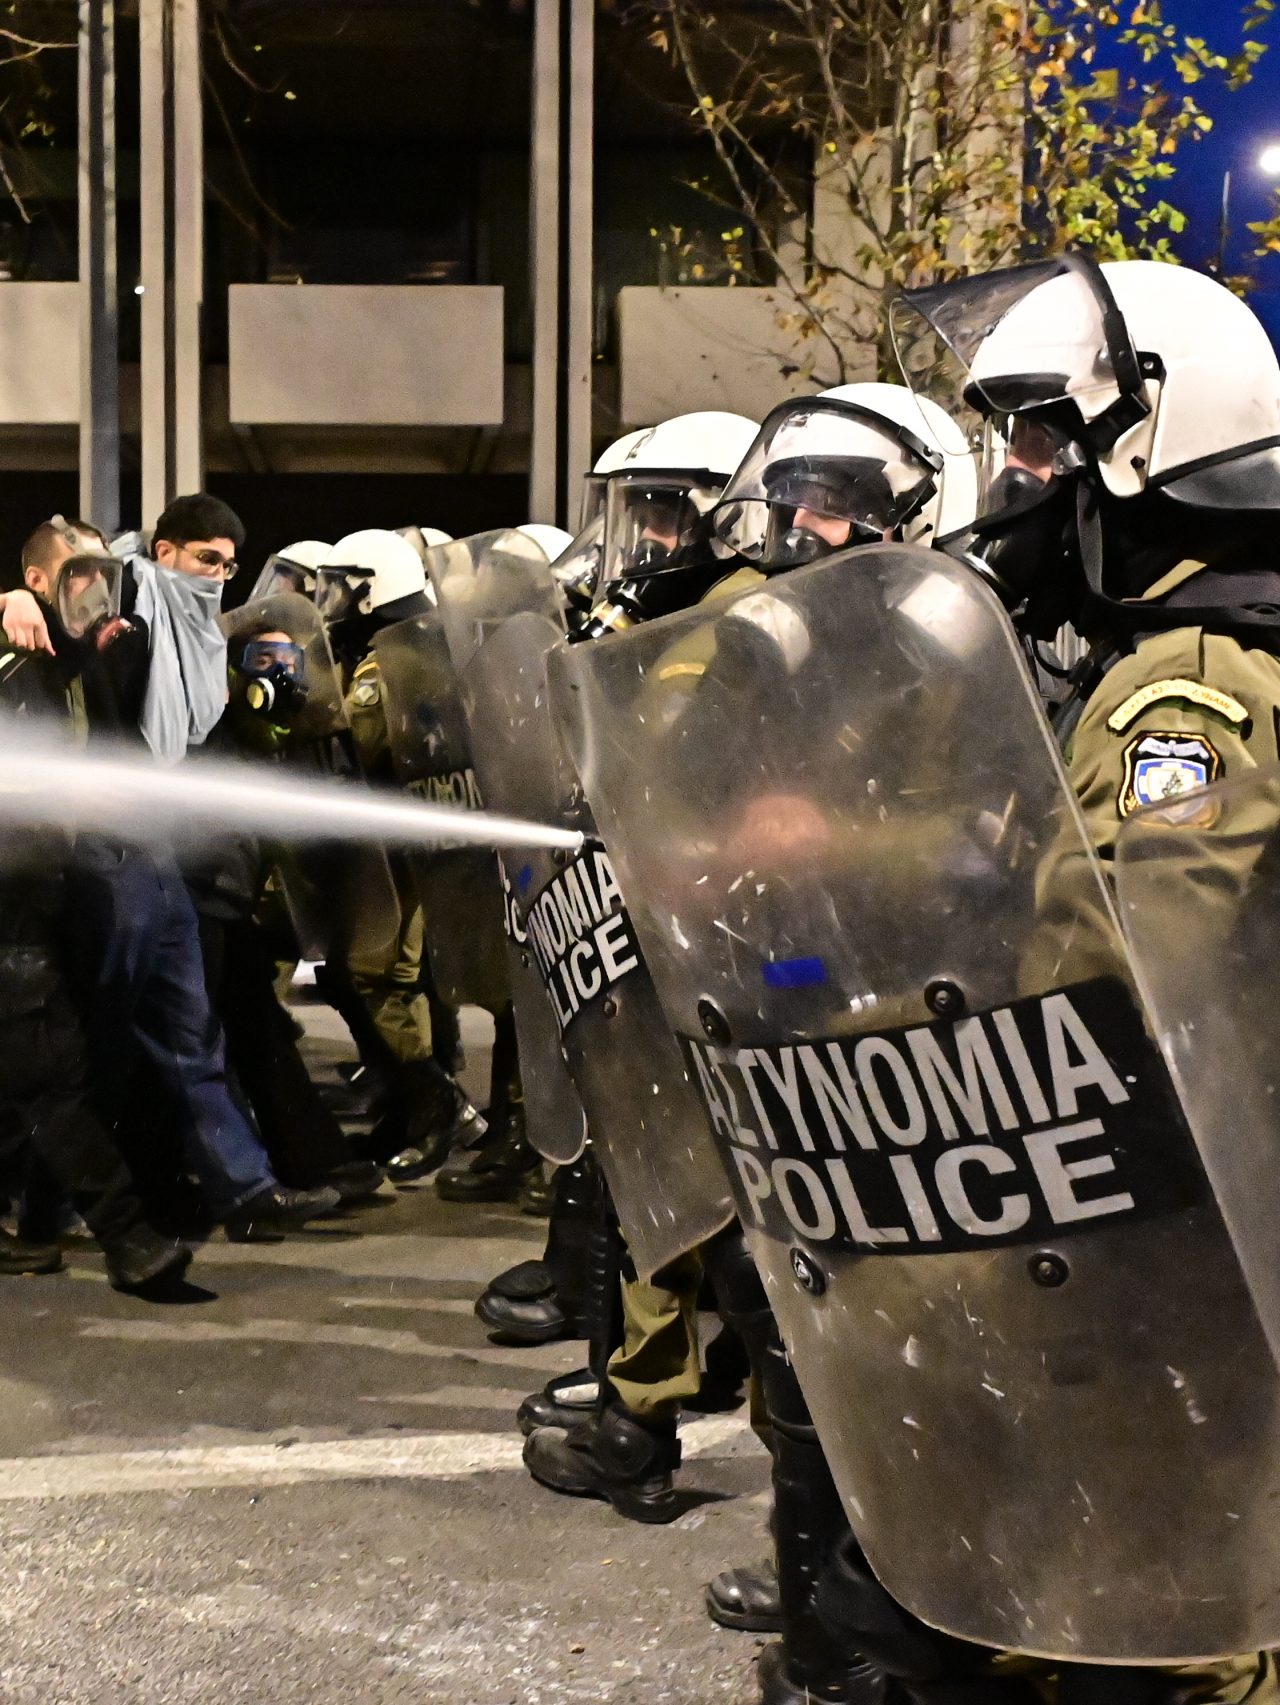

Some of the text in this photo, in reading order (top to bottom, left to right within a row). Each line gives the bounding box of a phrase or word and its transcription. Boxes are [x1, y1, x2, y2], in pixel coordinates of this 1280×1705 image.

[526, 850, 626, 980] ΝΟΜΙΑ
[547, 913, 638, 1029] LICE
[730, 1118, 1135, 1244] POLICE
